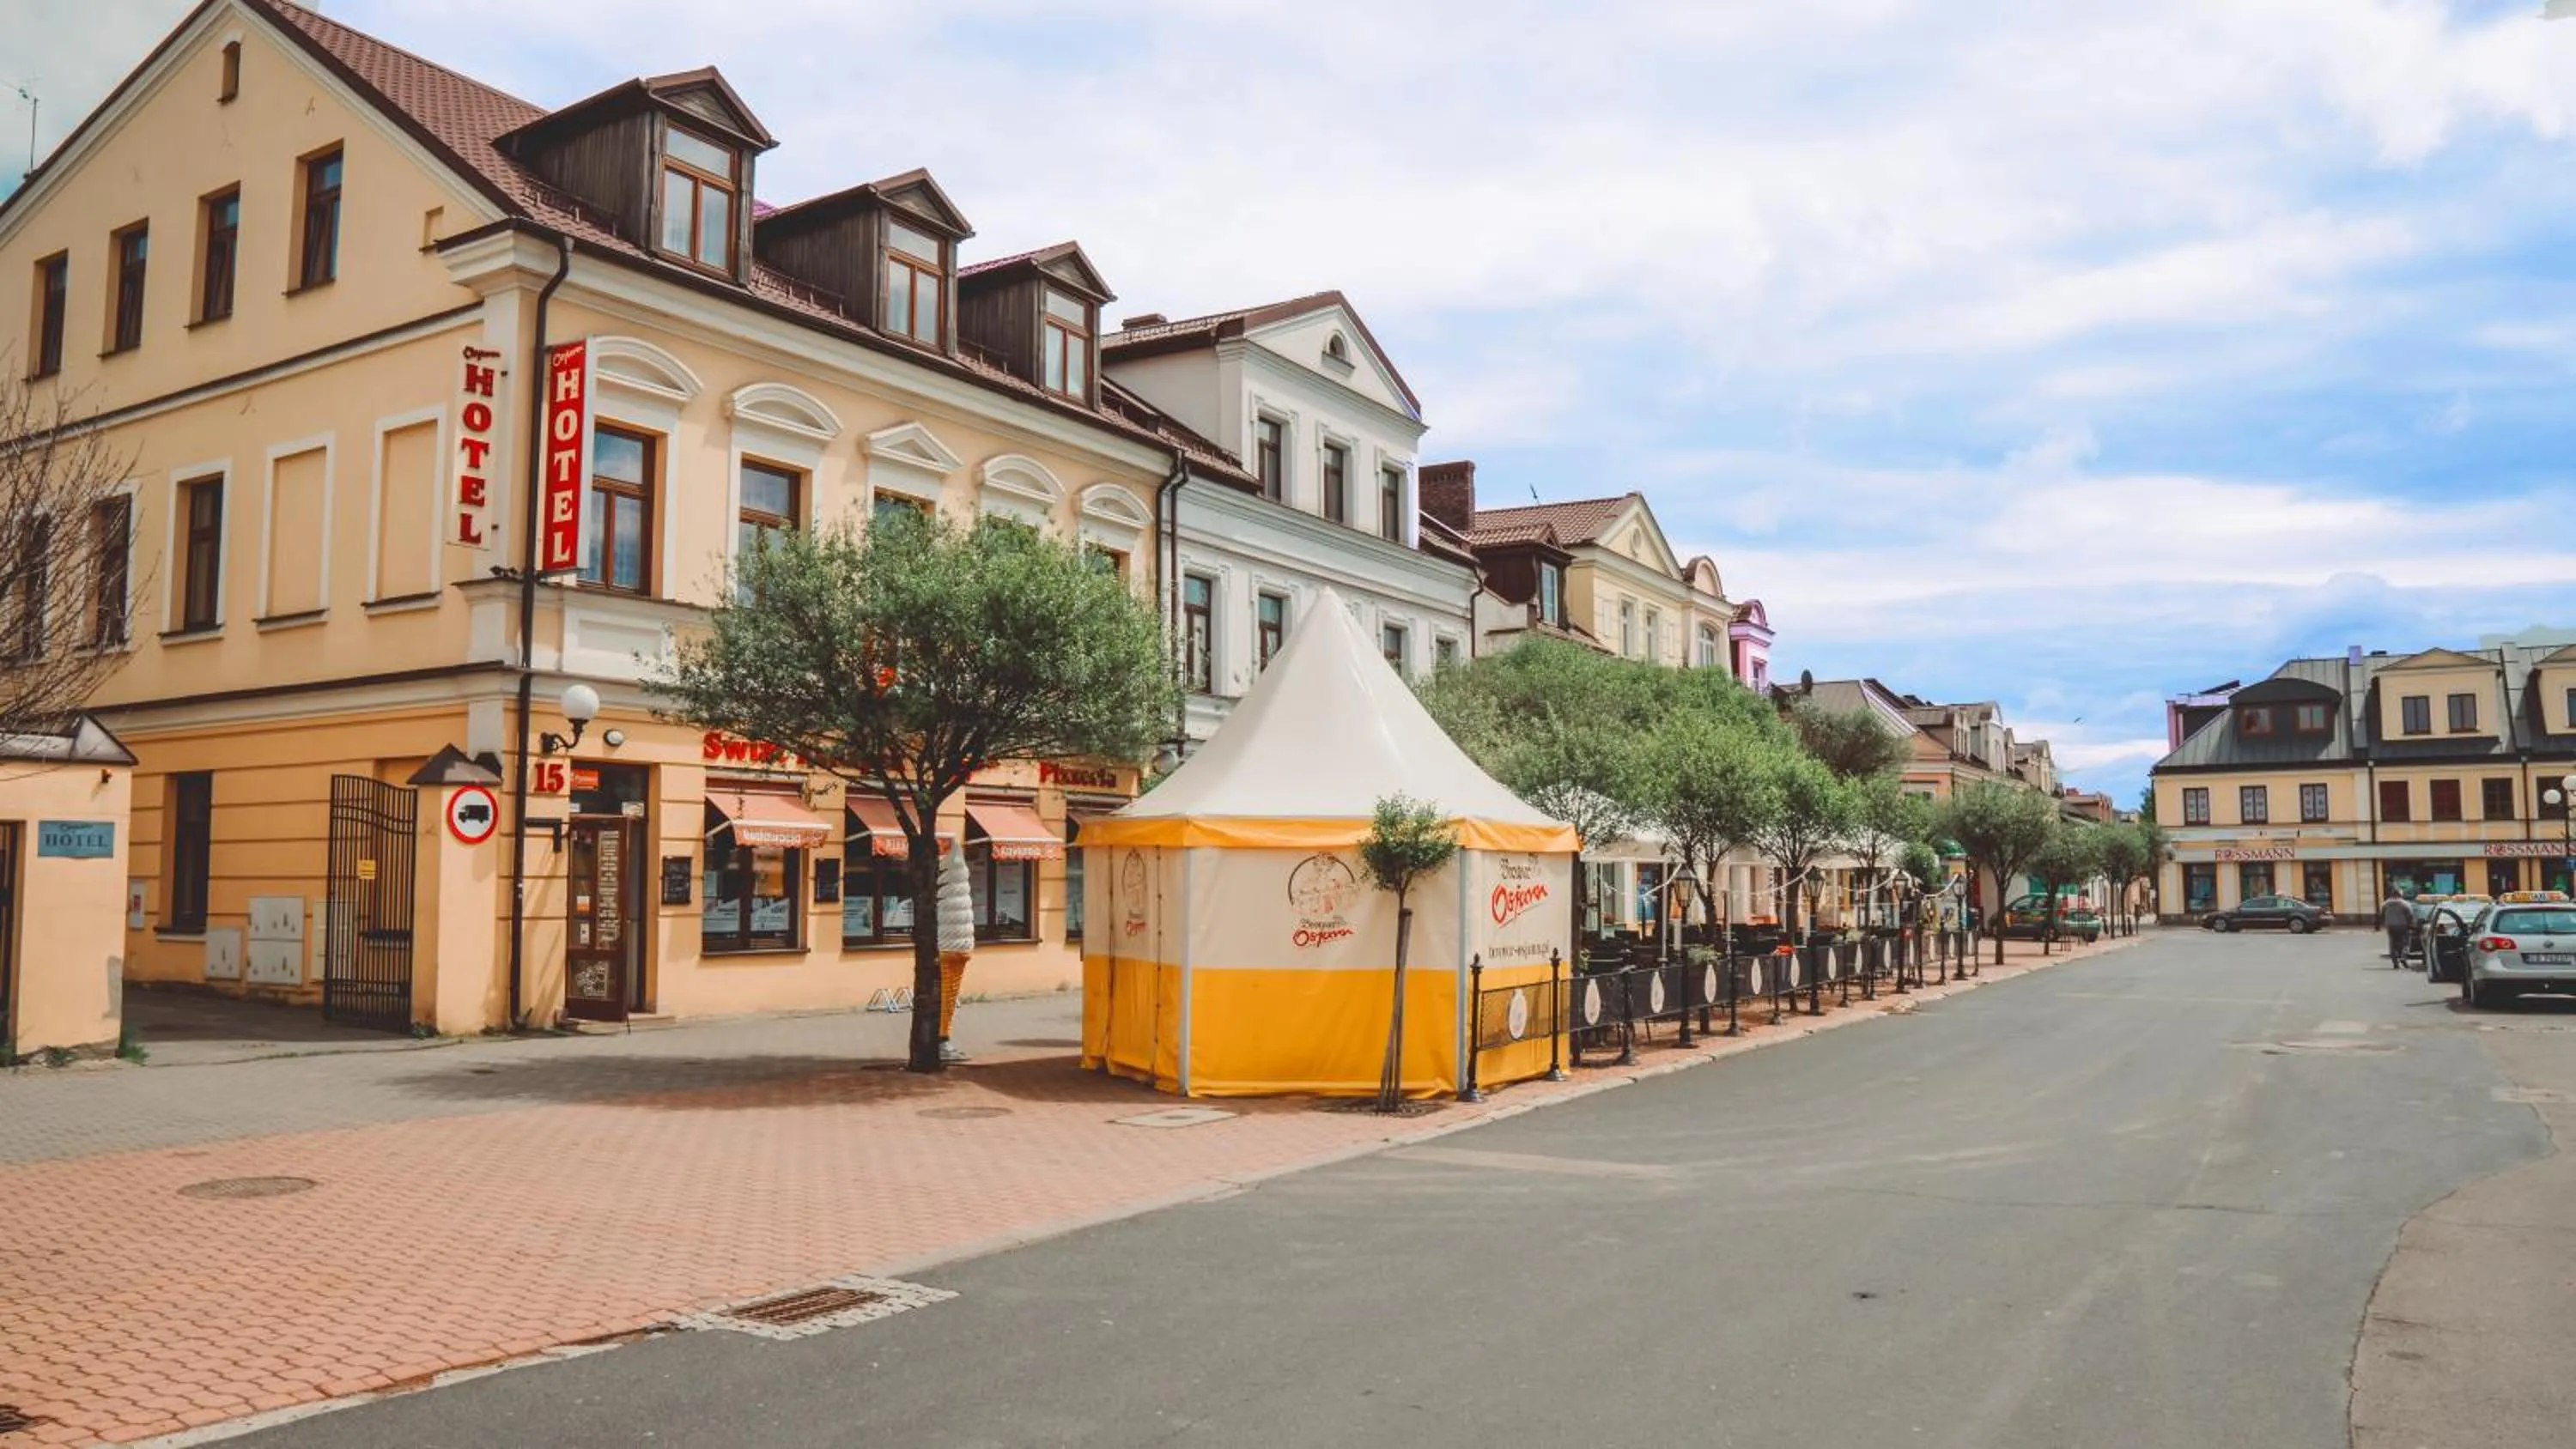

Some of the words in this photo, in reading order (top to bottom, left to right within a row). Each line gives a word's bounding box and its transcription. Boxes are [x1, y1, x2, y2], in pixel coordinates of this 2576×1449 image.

[459, 363, 495, 545] HOTEL
[552, 367, 580, 563] HOTEL
[534, 762, 564, 792] 15
[44, 834, 110, 848] HOTEL
[2215, 847, 2294, 859] ROSSMANN
